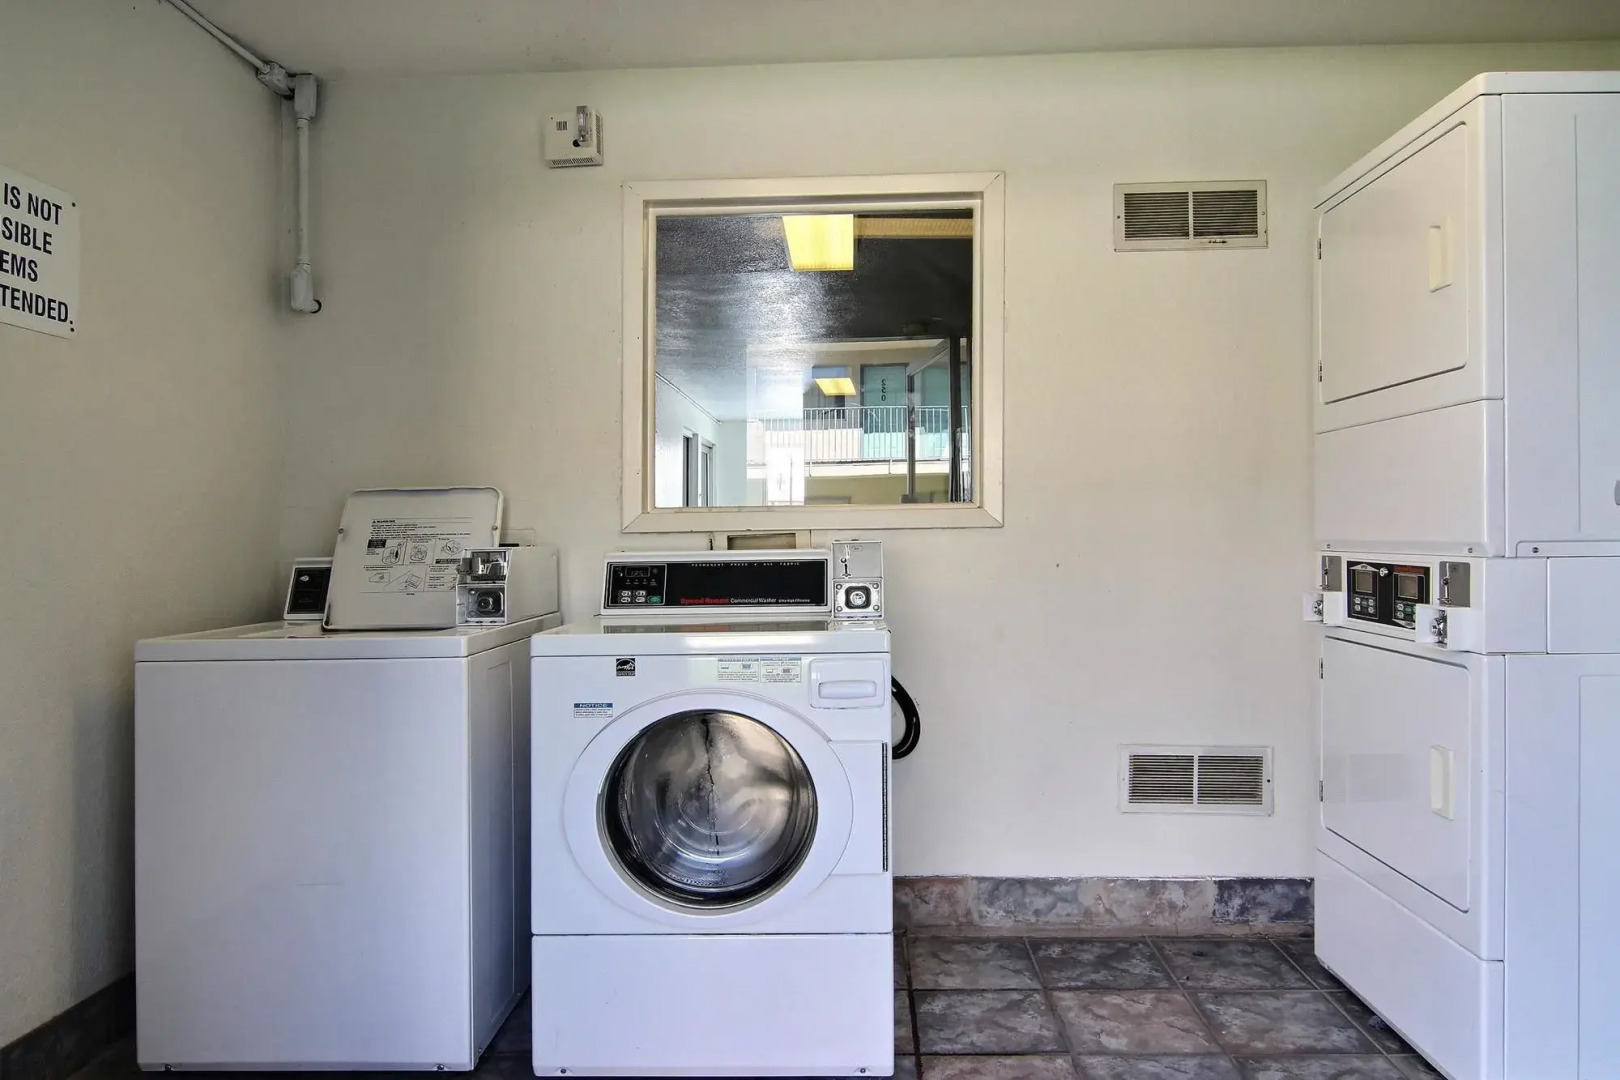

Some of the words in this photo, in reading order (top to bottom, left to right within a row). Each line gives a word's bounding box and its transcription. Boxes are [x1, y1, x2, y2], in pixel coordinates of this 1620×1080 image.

[4, 183, 21, 210] IS
[28, 192, 62, 225] NOT
[2, 216, 53, 255] SIBLE
[0, 249, 38, 283] EMS
[0, 283, 73, 325] TENDED.
